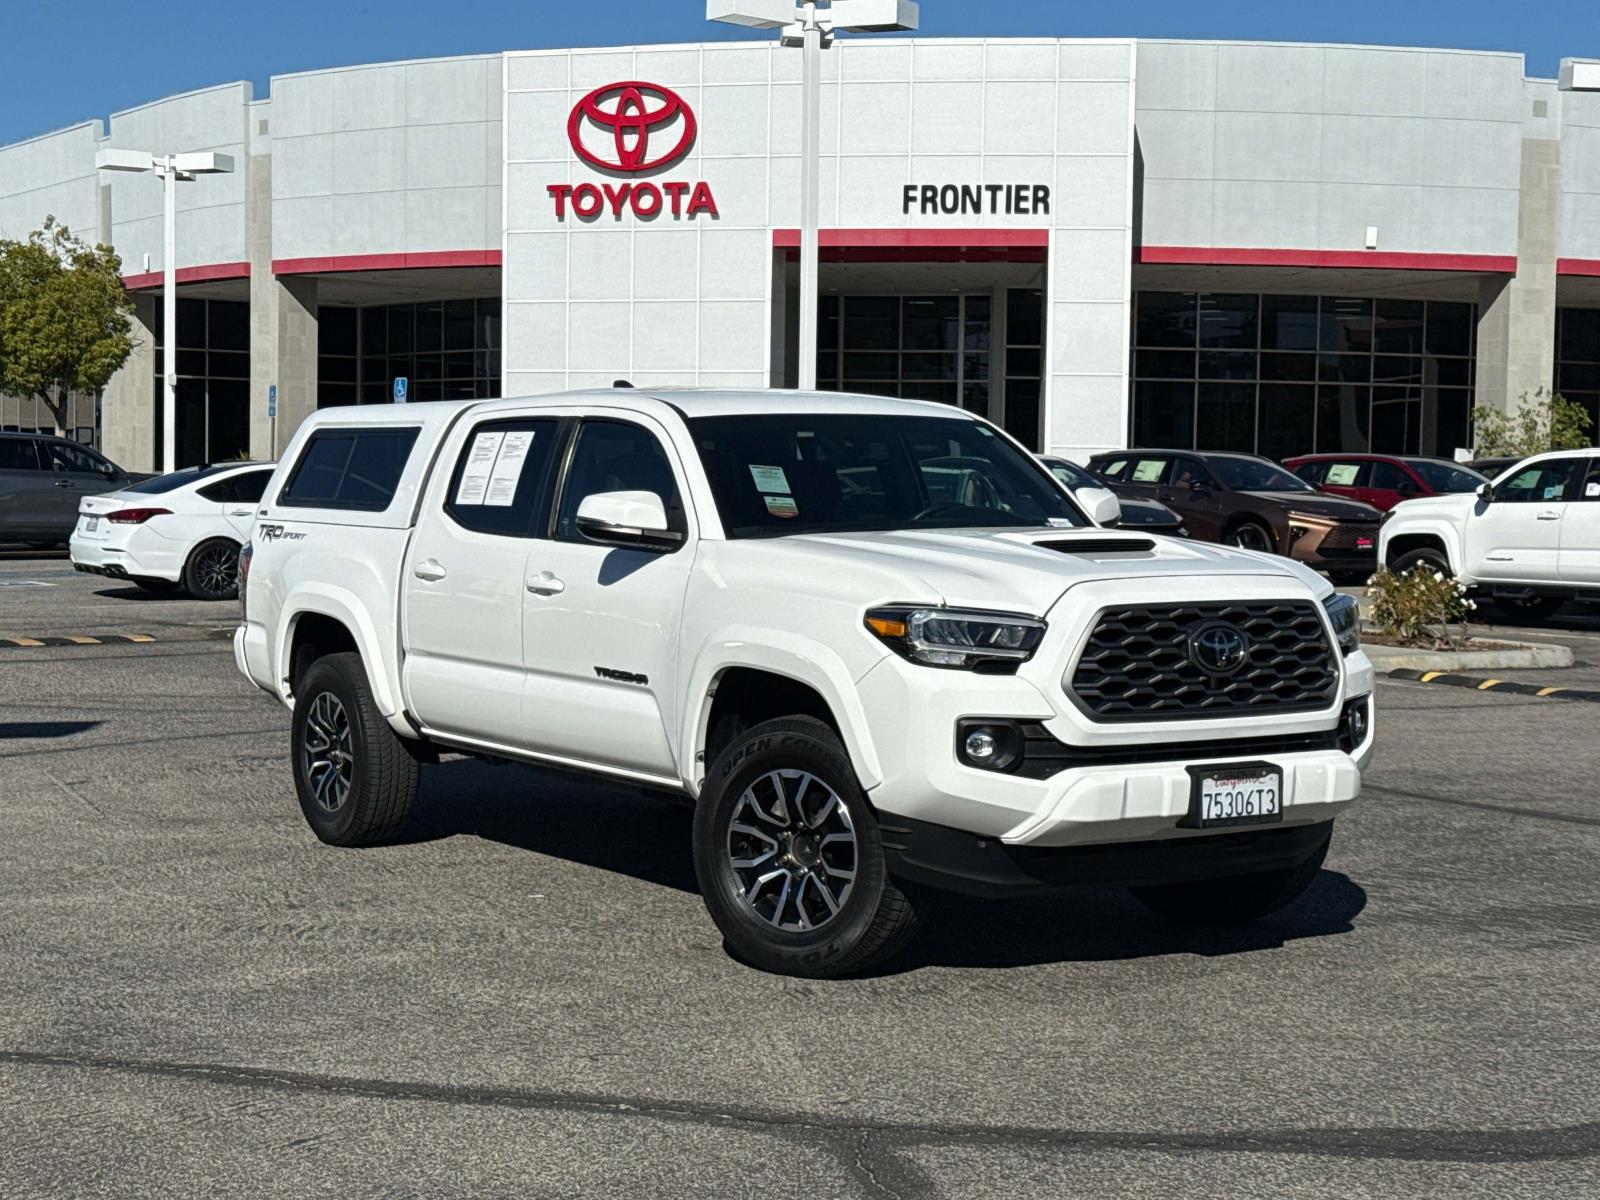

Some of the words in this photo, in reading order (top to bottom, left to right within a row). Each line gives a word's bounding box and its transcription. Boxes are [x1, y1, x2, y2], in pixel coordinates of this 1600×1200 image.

[547, 181, 718, 220] TOYOTA
[903, 184, 1050, 215] FRONTIER
[259, 524, 284, 543] TRD
[1203, 788, 1276, 819] 75306T3
